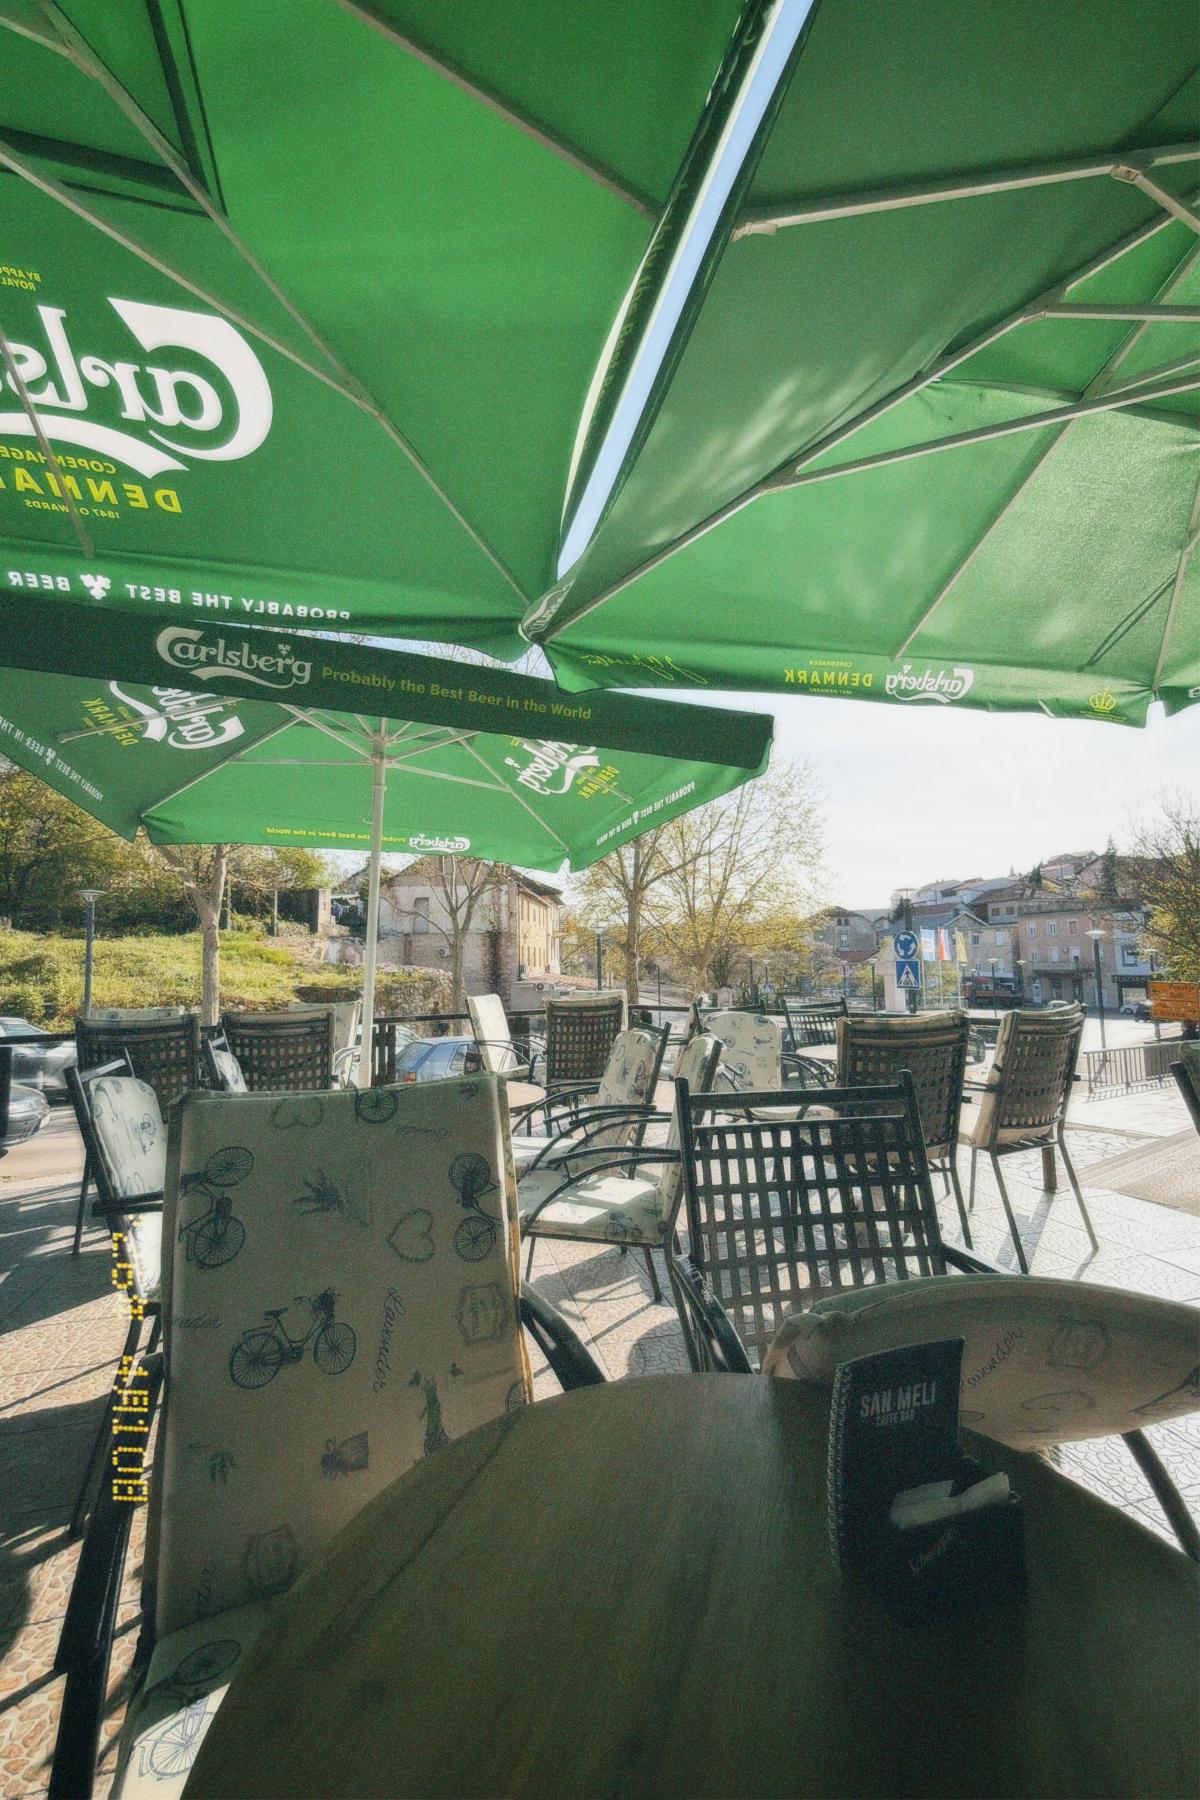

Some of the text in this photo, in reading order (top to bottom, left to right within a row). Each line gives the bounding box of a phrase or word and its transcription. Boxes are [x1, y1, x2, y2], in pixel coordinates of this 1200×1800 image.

[156, 626, 312, 688] Carlsberg
[321, 666, 591, 721] Probably the Best Beer in the World
[964, 1327, 1023, 1388] avender
[860, 1381, 936, 1418] SAN MELI
